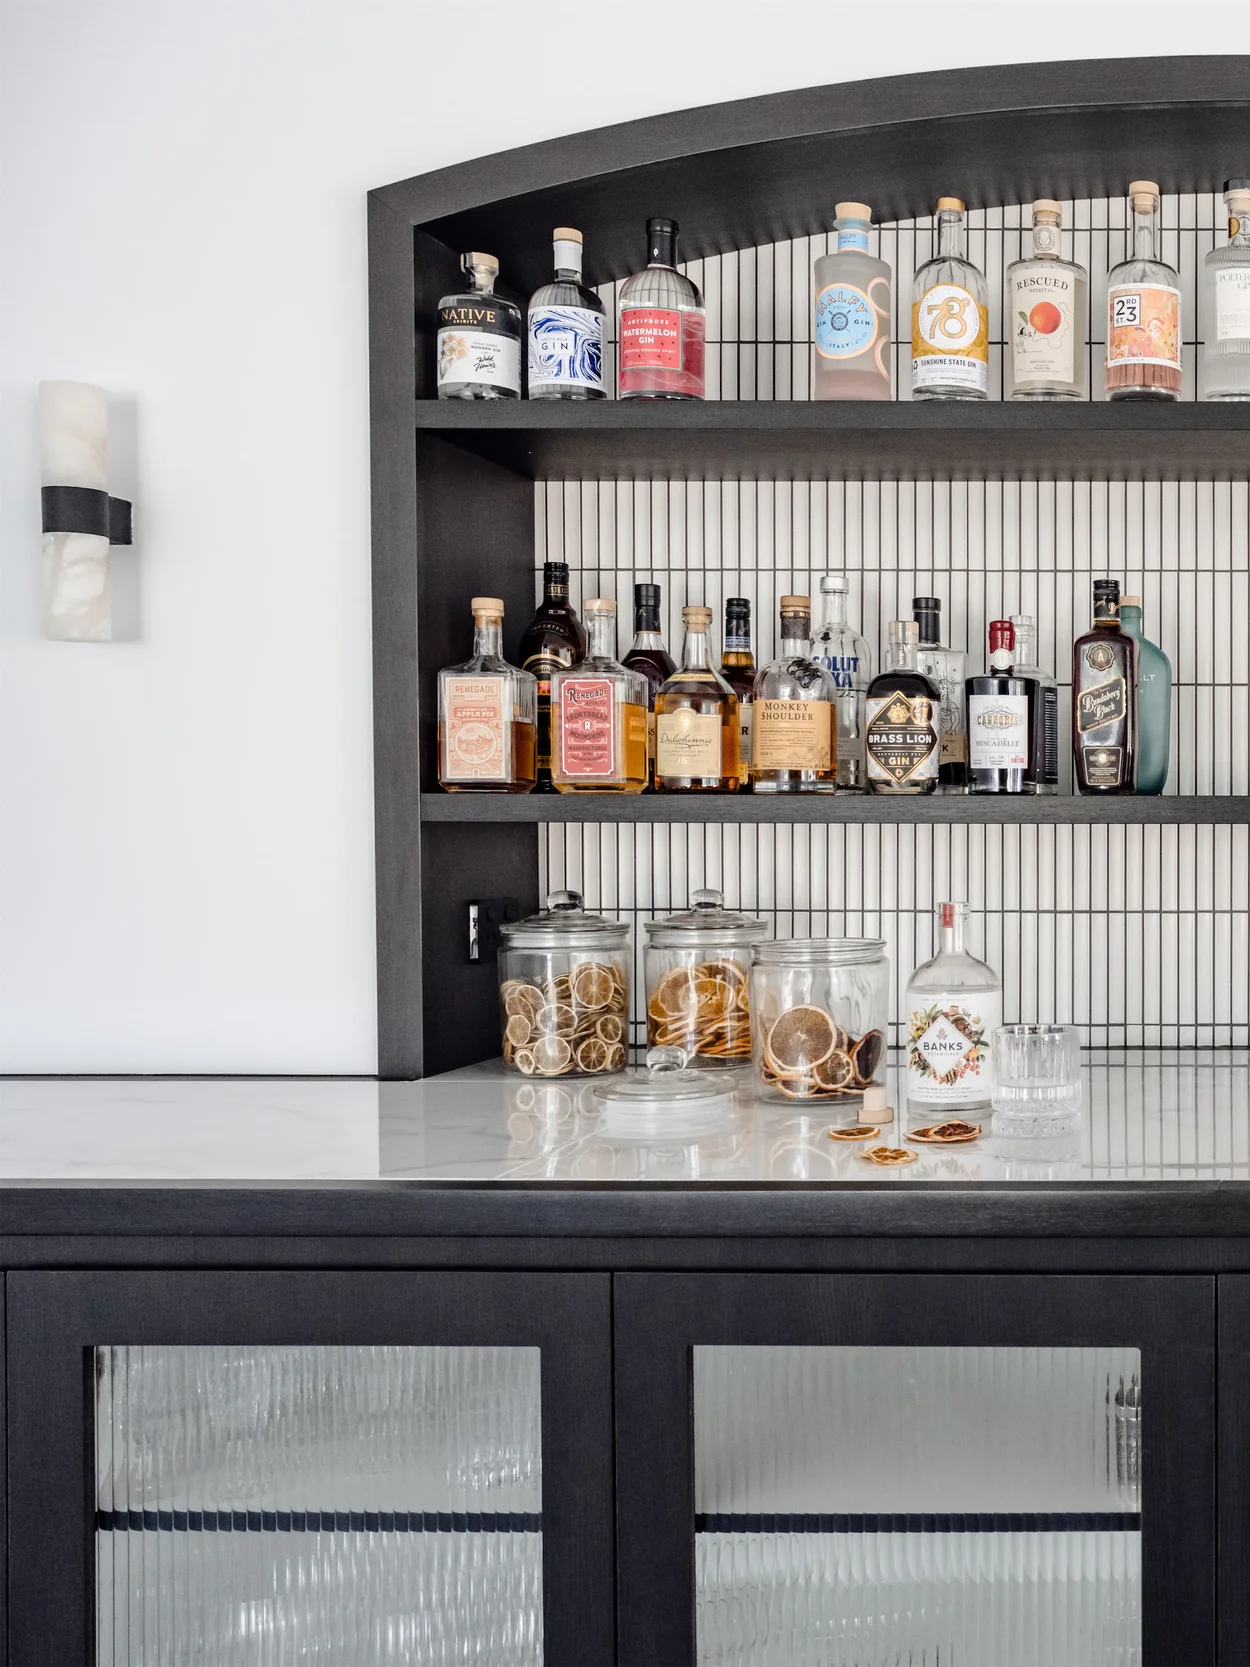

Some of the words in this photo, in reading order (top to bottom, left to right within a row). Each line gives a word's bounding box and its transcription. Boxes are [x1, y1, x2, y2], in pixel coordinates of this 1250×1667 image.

[1016, 276, 1069, 291] RESCUED
[818, 291, 868, 316] MALFY
[441, 308, 496, 323] NATIVE
[854, 318, 870, 326] GIN
[623, 328, 677, 337] WATERMELON
[638, 336, 655, 344] GIN
[541, 342, 568, 350] GIN
[920, 358, 947, 366] SUNSHINE
[948, 358, 966, 367] STATE
[967, 360, 977, 368] GIN
[813, 656, 860, 673] SOLUT
[455, 685, 496, 694] RENEGADE
[1082, 688, 1121, 713] Bundaberg
[764, 702, 809, 711] MONKEY
[1093, 701, 1116, 721] Black
[566, 710, 609, 723] SHORTBREAD
[761, 711, 814, 721] SHOULDER
[584, 721, 591, 730] R
[568, 729, 606, 740] MOONSHINE
[660, 732, 713, 745] Dalwhinnie
[868, 734, 904, 744] BRASS
[906, 734, 932, 744] LION
[888, 756, 910, 766] GIN
[923, 1042, 964, 1051] BANKS
